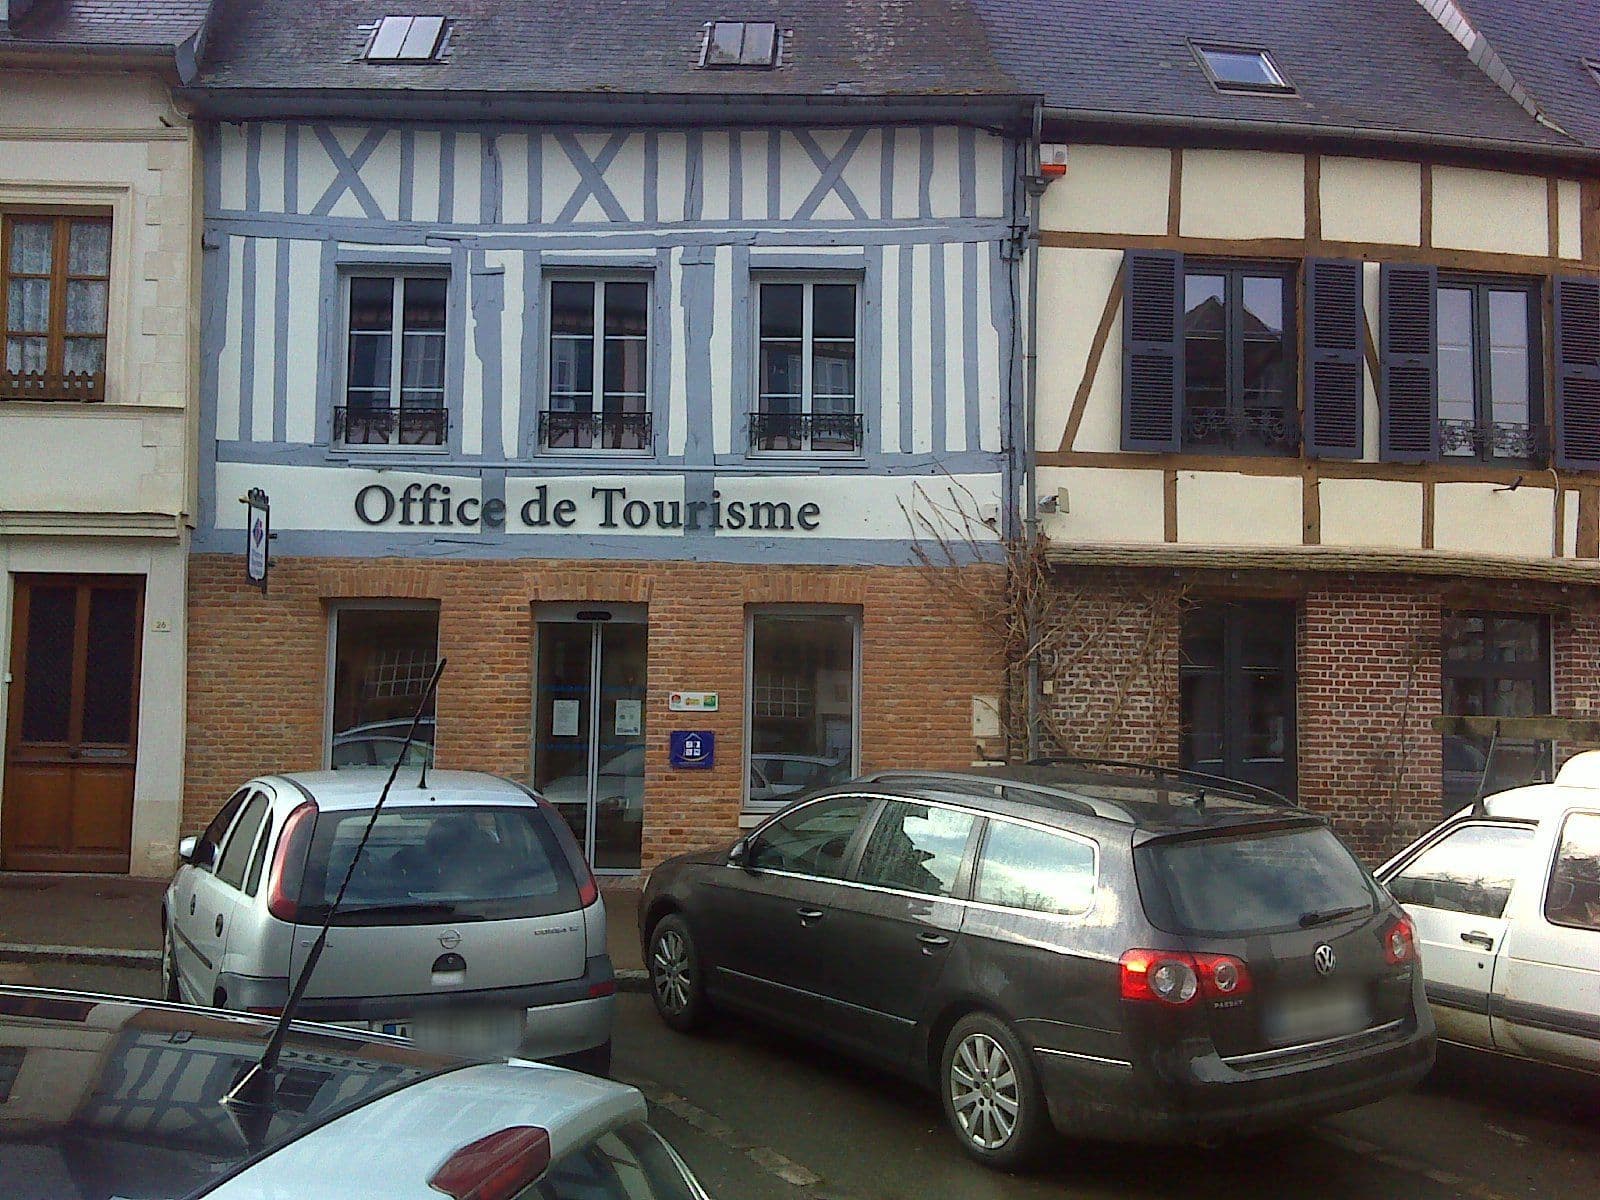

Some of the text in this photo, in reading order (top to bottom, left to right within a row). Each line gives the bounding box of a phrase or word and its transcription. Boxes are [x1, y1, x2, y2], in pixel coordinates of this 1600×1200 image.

[355, 483, 820, 530] Office de Tourisme
[155, 620, 167, 629] 26
